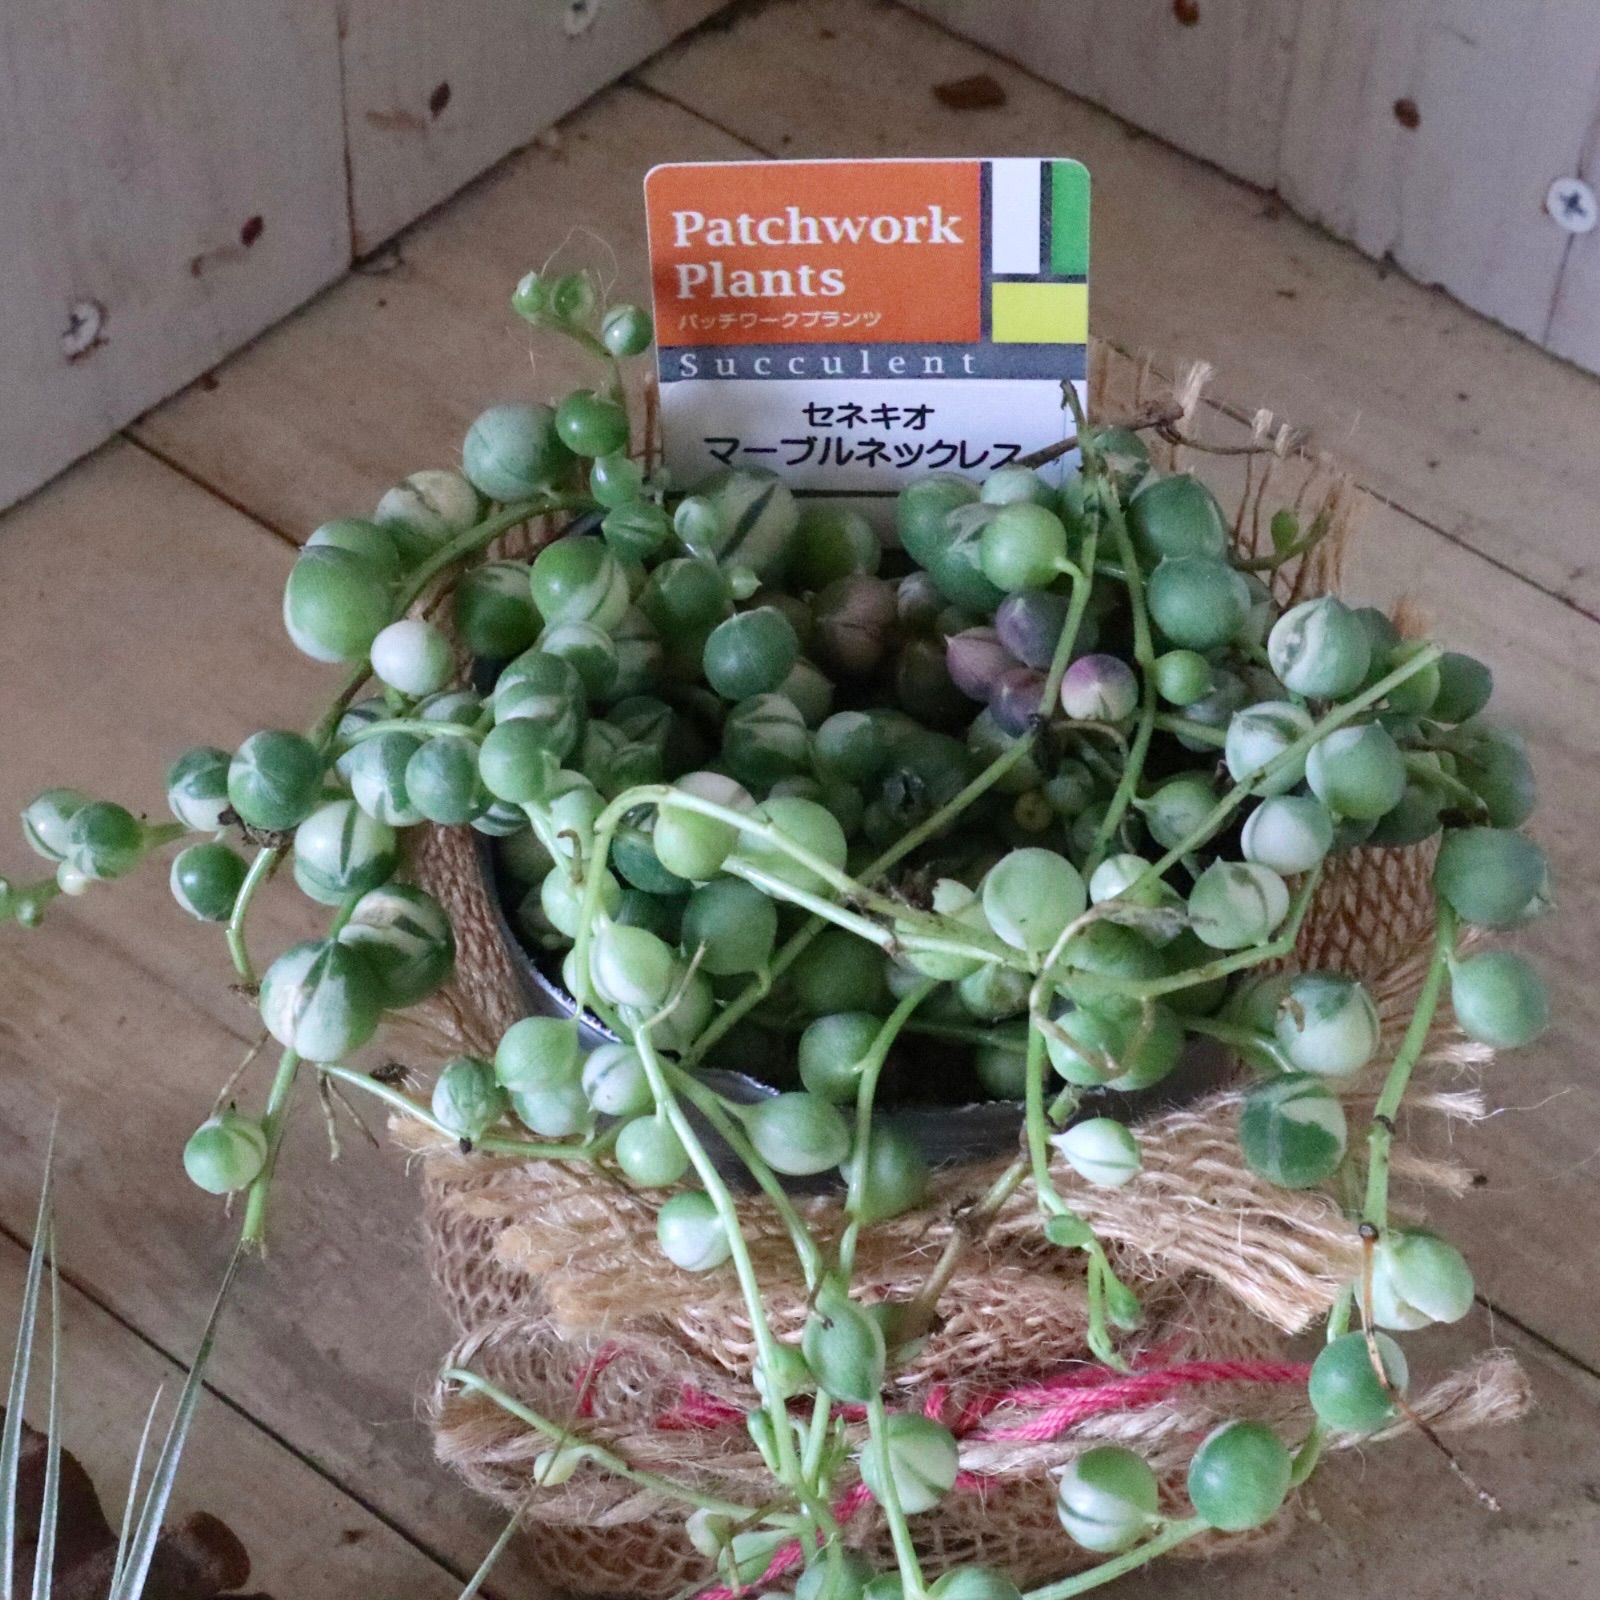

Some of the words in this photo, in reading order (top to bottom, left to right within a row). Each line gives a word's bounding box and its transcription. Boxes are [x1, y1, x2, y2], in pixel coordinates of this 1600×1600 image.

[672, 205, 964, 247] Patchwork
[675, 261, 846, 299] Plants
[680, 350, 976, 377] Succulent
[802, 402, 935, 430] セネキオ
[704, 437, 1022, 470] マーブルネックレス
